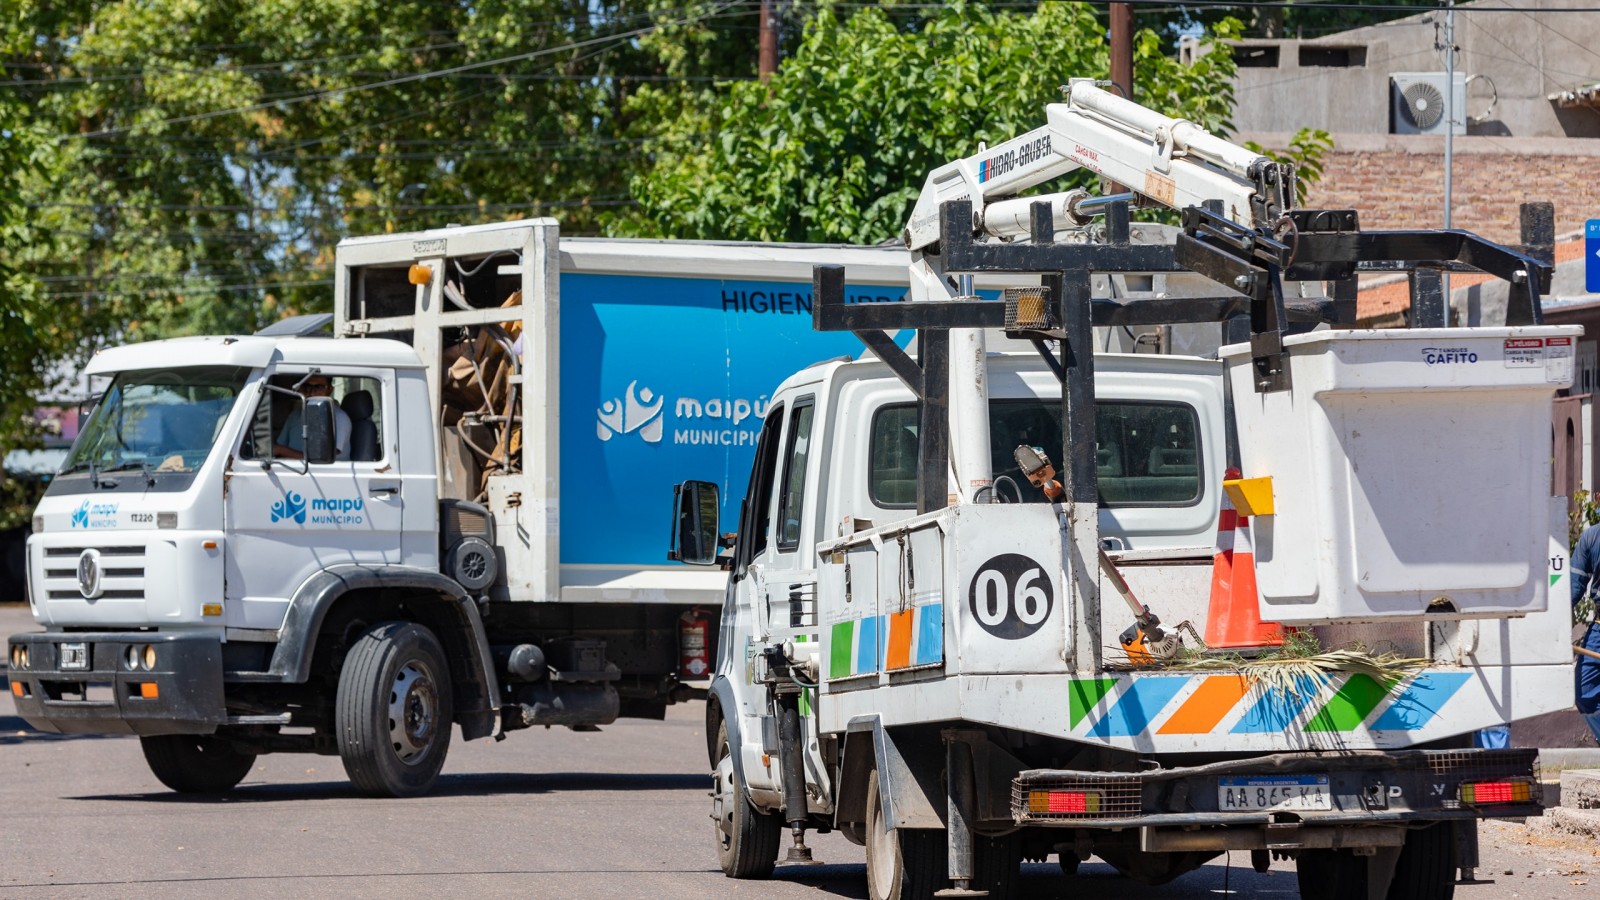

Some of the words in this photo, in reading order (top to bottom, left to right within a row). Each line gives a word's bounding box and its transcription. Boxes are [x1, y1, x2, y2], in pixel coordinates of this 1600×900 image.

[721, 290, 813, 315] HIGIEN
[1427, 352, 1478, 365] CAFITO
[675, 394, 769, 426] maipú
[312, 496, 363, 513] maipú
[90, 520, 118, 528] MUNICIPIO
[312, 515, 363, 524] MUNICIPIO
[975, 567, 1048, 626] 06
[1226, 788, 1249, 808] AA
[1256, 787, 1293, 808] 865
